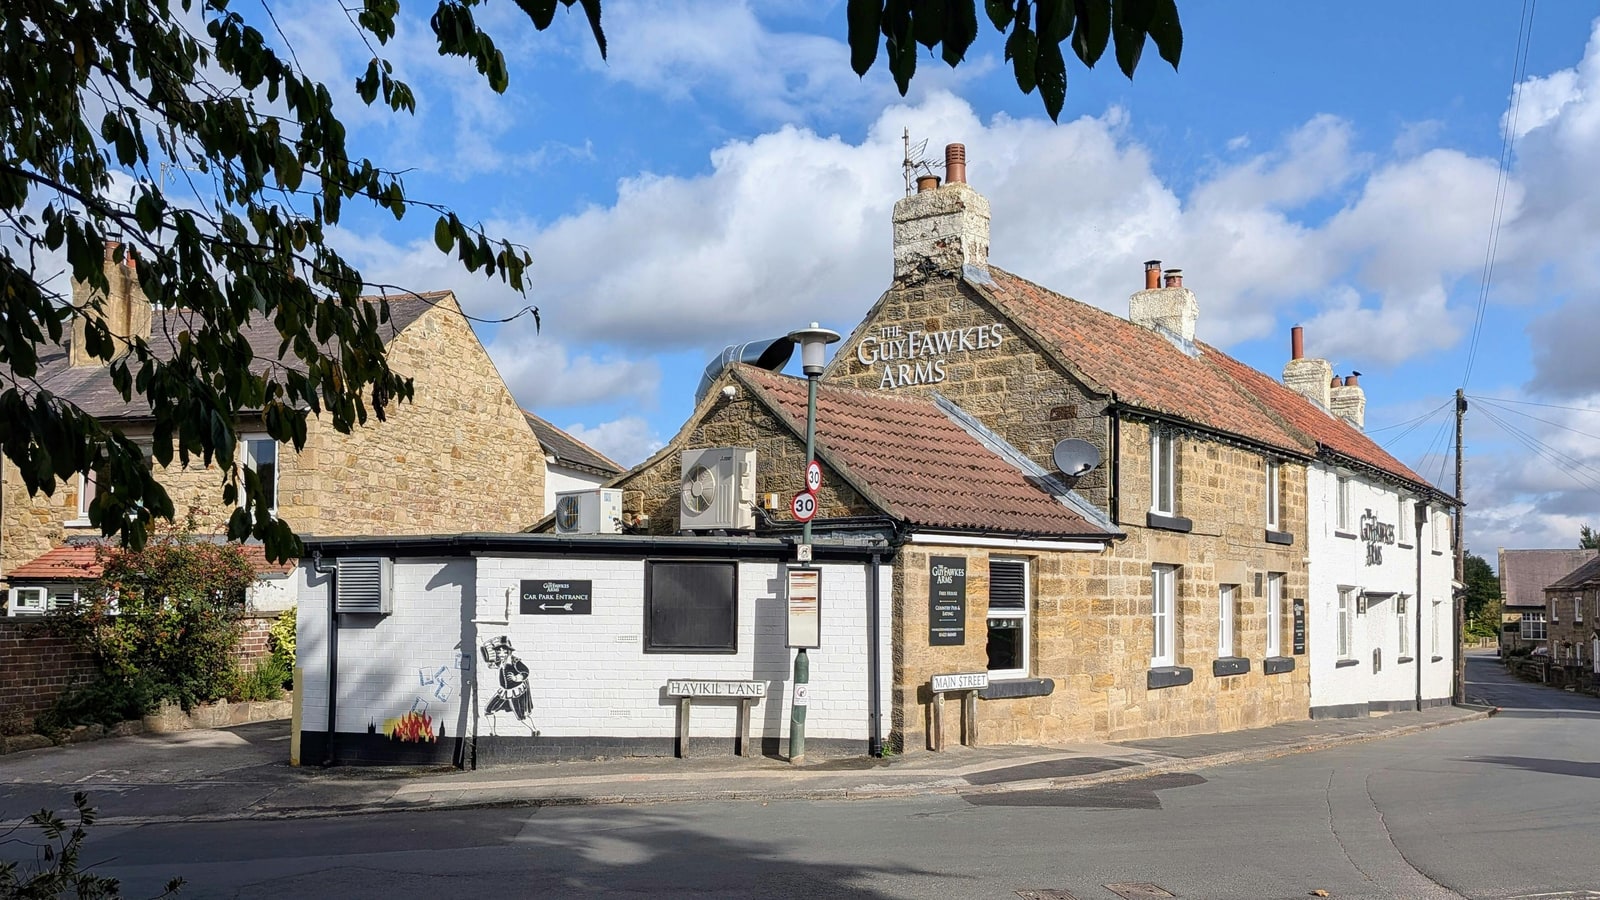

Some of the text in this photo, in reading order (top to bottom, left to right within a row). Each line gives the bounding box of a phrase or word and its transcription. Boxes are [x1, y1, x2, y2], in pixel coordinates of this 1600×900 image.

[880, 325, 901, 338] THE
[879, 359, 946, 390] ARMS
[809, 471, 819, 483] 30
[795, 499, 814, 512] 30
[671, 682, 763, 695] HAVIKIL LANE
[935, 675, 986, 689] MAIN STREET
